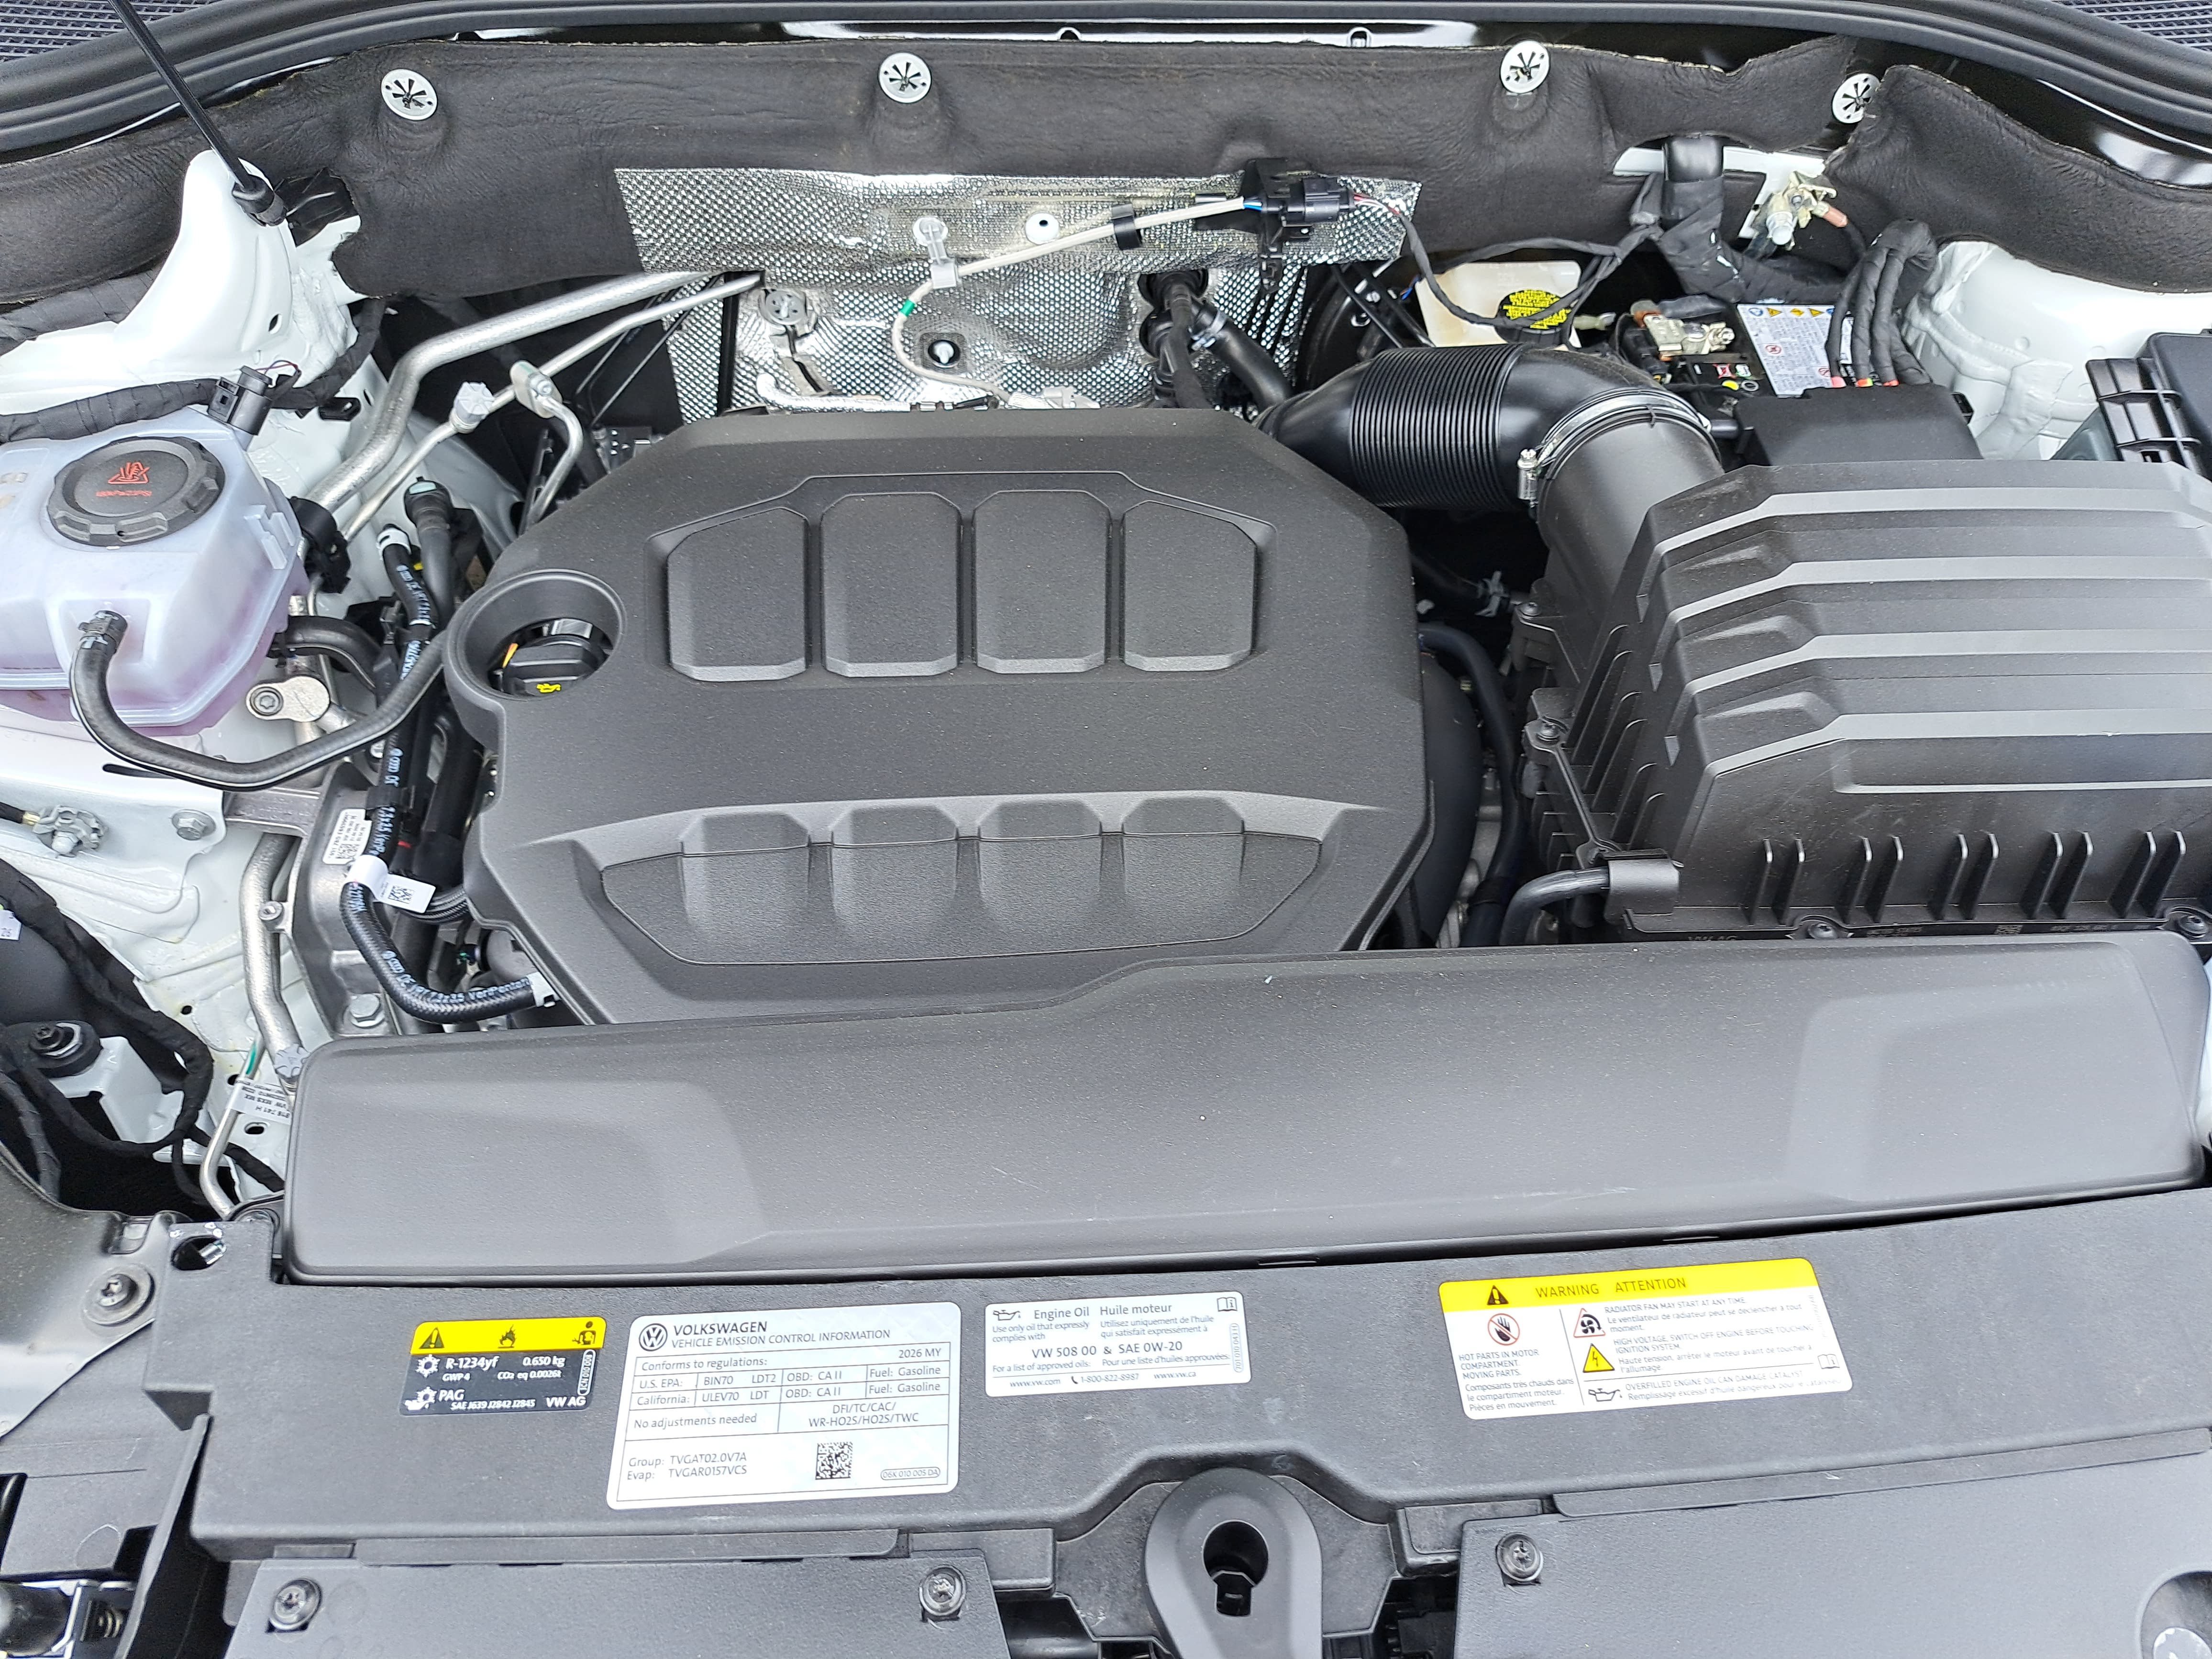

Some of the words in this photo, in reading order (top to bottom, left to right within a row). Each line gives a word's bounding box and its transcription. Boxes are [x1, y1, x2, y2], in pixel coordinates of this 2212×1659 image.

[1535, 1283, 1600, 1298] WARNING
[1615, 1277, 1687, 1293] ATTENTION
[1604, 1304, 1643, 1314] RADIATOR
[673, 1321, 767, 1336] VOLKSWAGEN
[672, 1338, 713, 1348] VEHICLE
[716, 1335, 765, 1346] EMISSION
[768, 1333, 816, 1344] CONTROL
[819, 1329, 890, 1341] INFORMATION
[898, 1349, 922, 1359] 2026
[925, 1348, 941, 1357] MY
[1031, 1348, 1053, 1359] VW
[445, 1356, 499, 1371] R-1234yf
[552, 1356, 565, 1367] kg
[642, 1361, 691, 1371] Conforms
[693, 1360, 704, 1369] to
[707, 1357, 767, 1368] regulations:
[818, 1371, 832, 1380] CA
[870, 1368, 893, 1378] Fuel:
[898, 1366, 941, 1376] Gasoline
[704, 1376, 734, 1386] BIN70
[752, 1374, 776, 1383] LDT2
[787, 1372, 813, 1382] OBD:
[661, 1378, 683, 1388] EPA:
[897, 1382, 940, 1393] Gasoline
[785, 1388, 811, 1398] OBD:
[817, 1387, 831, 1397] CA
[869, 1384, 892, 1394] Fuel:
[438, 1389, 465, 1401] PAG
[637, 1394, 689, 1405] California:
[702, 1392, 740, 1402] ULEV70
[750, 1390, 770, 1400] LDT
[546, 1397, 567, 1407] VW
[567, 1396, 586, 1406] AG
[832, 1402, 896, 1414] DFI/TC/CAC/
[634, 1419, 649, 1428] No
[651, 1417, 716, 1430] adjustments
[719, 1413, 757, 1424] needed
[808, 1413, 919, 1427] WR-HO2S/HO2S/TWC
[629, 1458, 664, 1468] Group:
[670, 1452, 747, 1464] TVGAT02.0V7A
[627, 1471, 654, 1481] Evap:
[668, 1465, 747, 1477] TVGAR0157VCS
